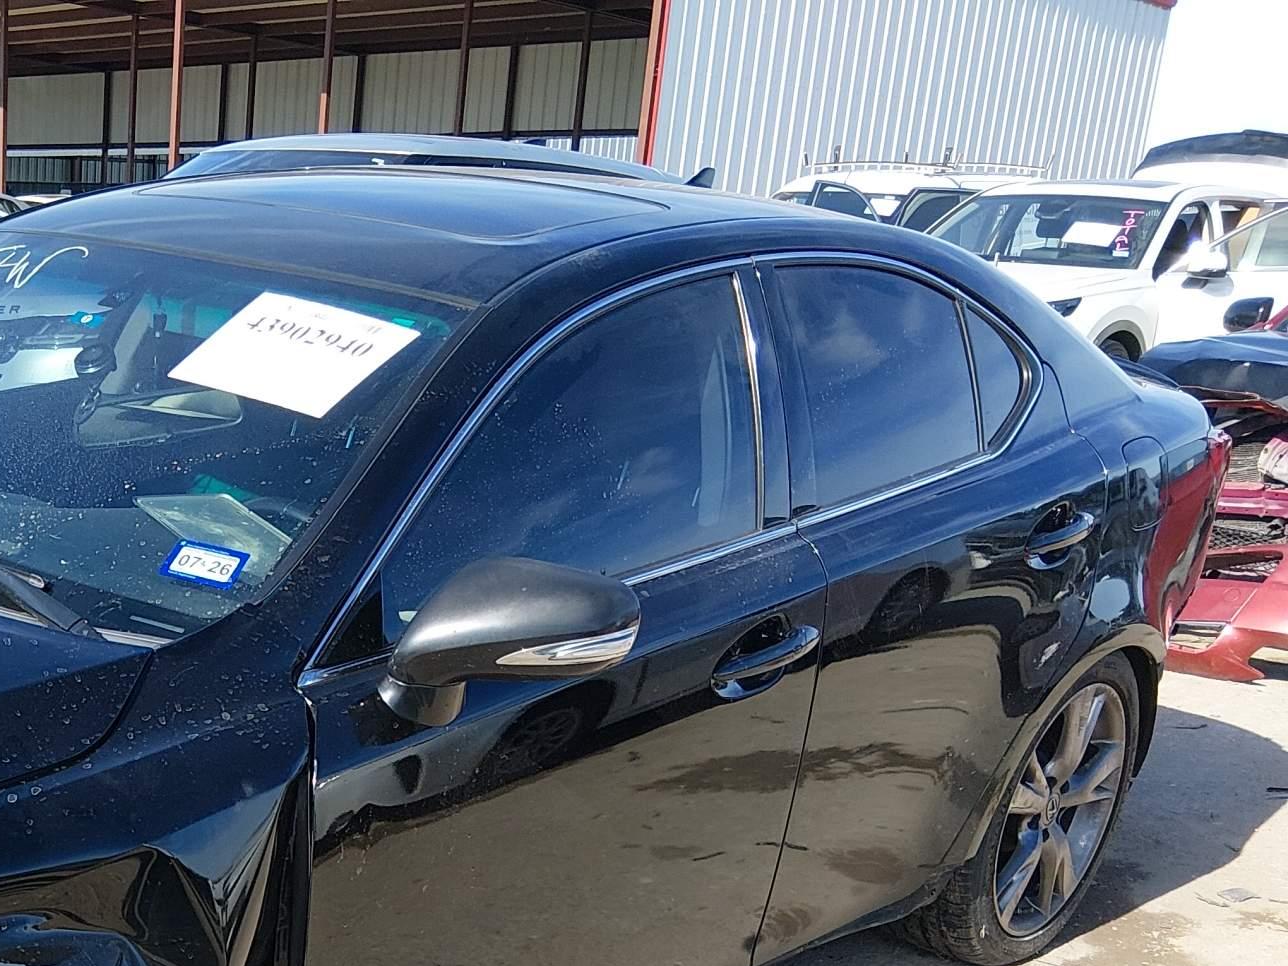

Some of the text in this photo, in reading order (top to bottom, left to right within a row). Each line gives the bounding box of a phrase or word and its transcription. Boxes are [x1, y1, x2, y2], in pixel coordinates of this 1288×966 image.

[1114, 210, 1145, 251] TOTAL
[246, 315, 375, 357] 43902940
[177, 554, 203, 569] 07
[207, 560, 233, 576] 26
